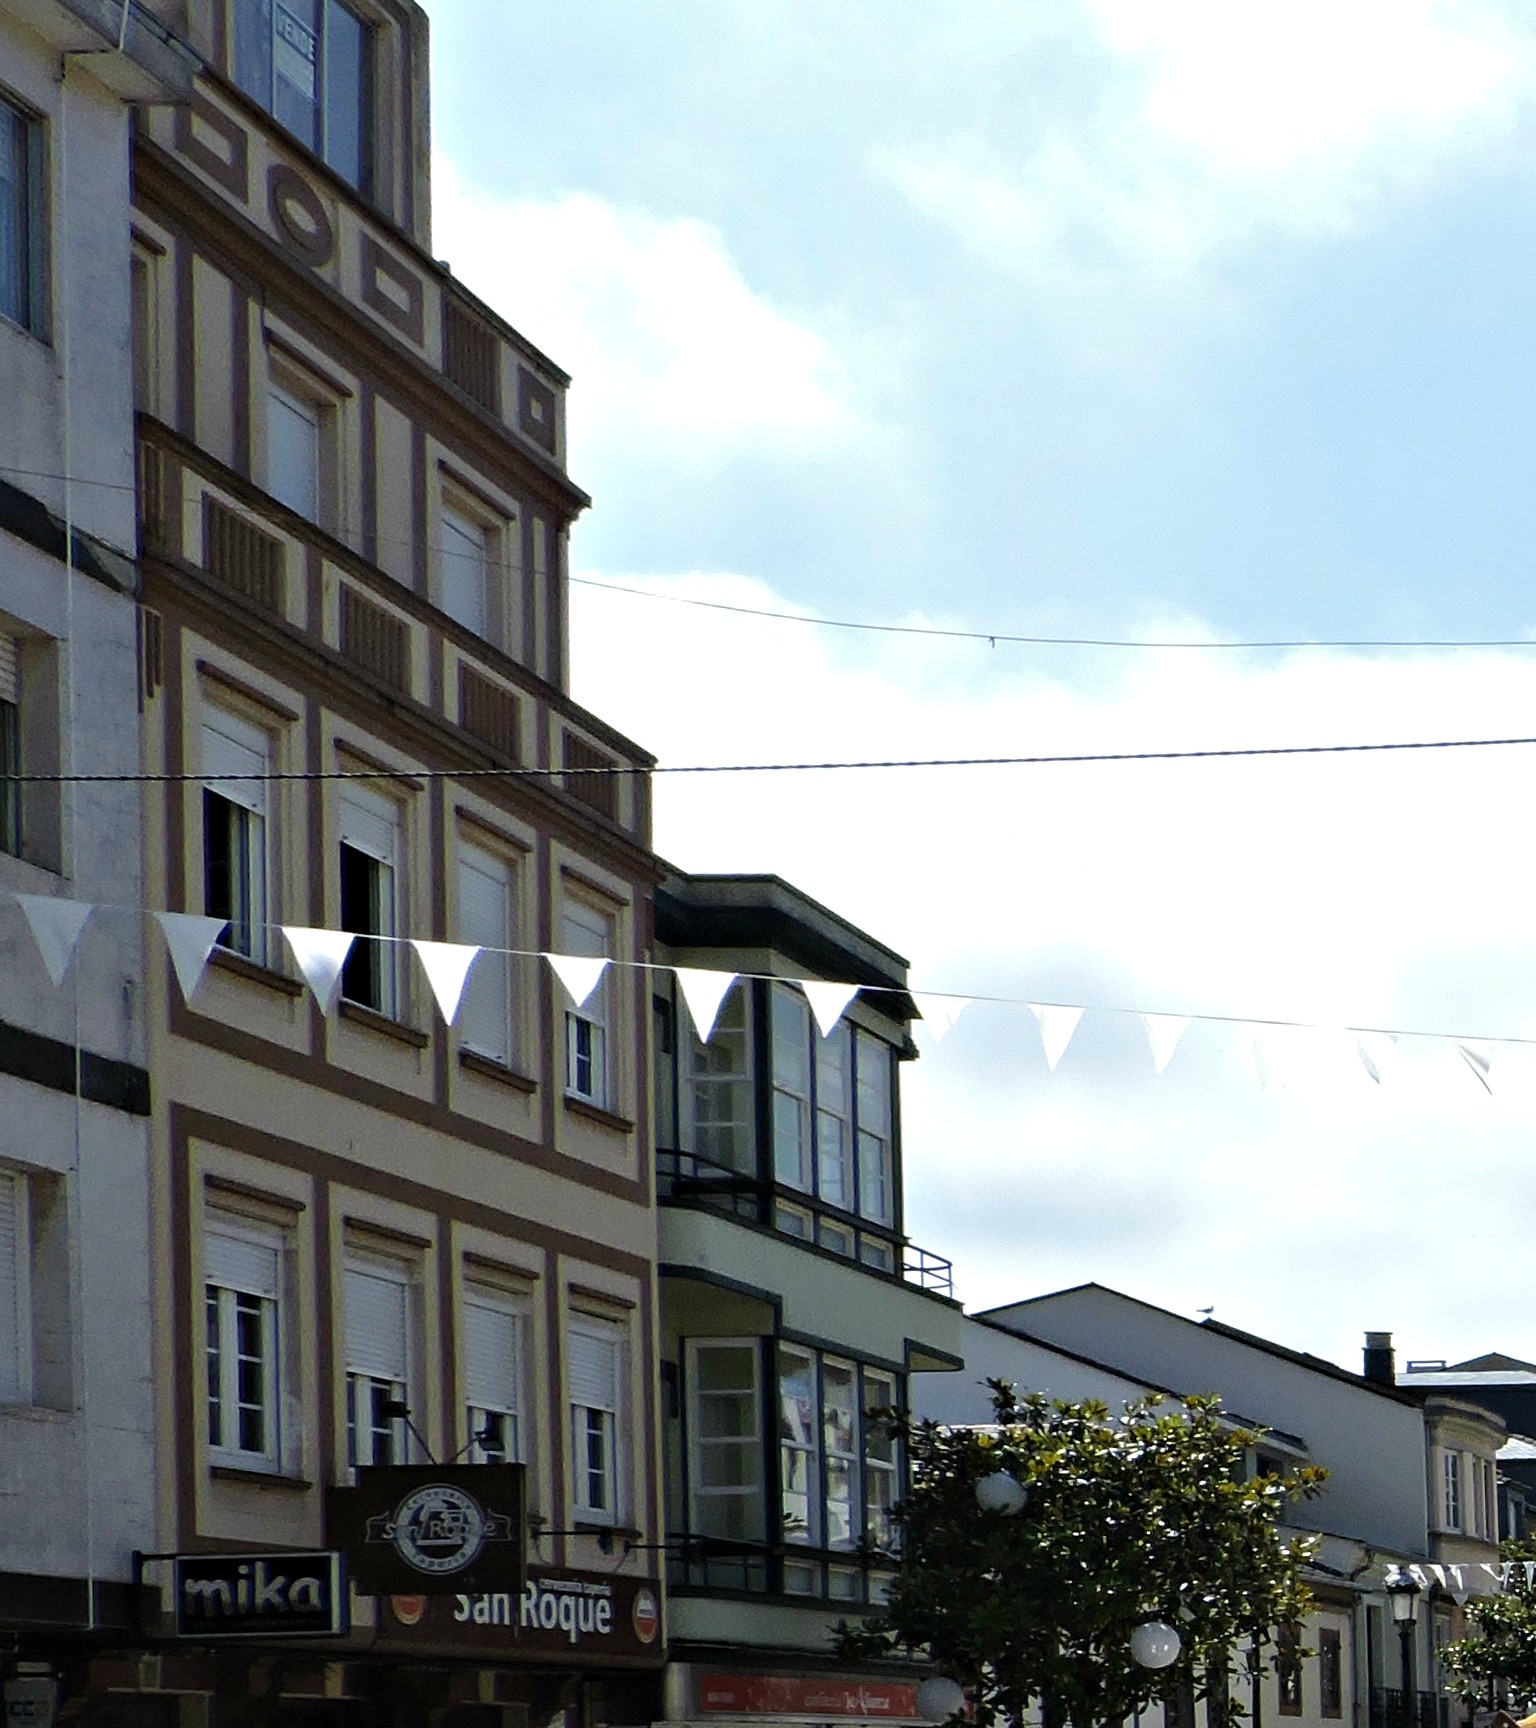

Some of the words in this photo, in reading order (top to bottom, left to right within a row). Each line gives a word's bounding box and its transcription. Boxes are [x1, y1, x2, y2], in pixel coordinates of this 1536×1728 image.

[184, 1560, 323, 1617] mika
[453, 1592, 511, 1625] San
[519, 1580, 612, 1644] Roque
